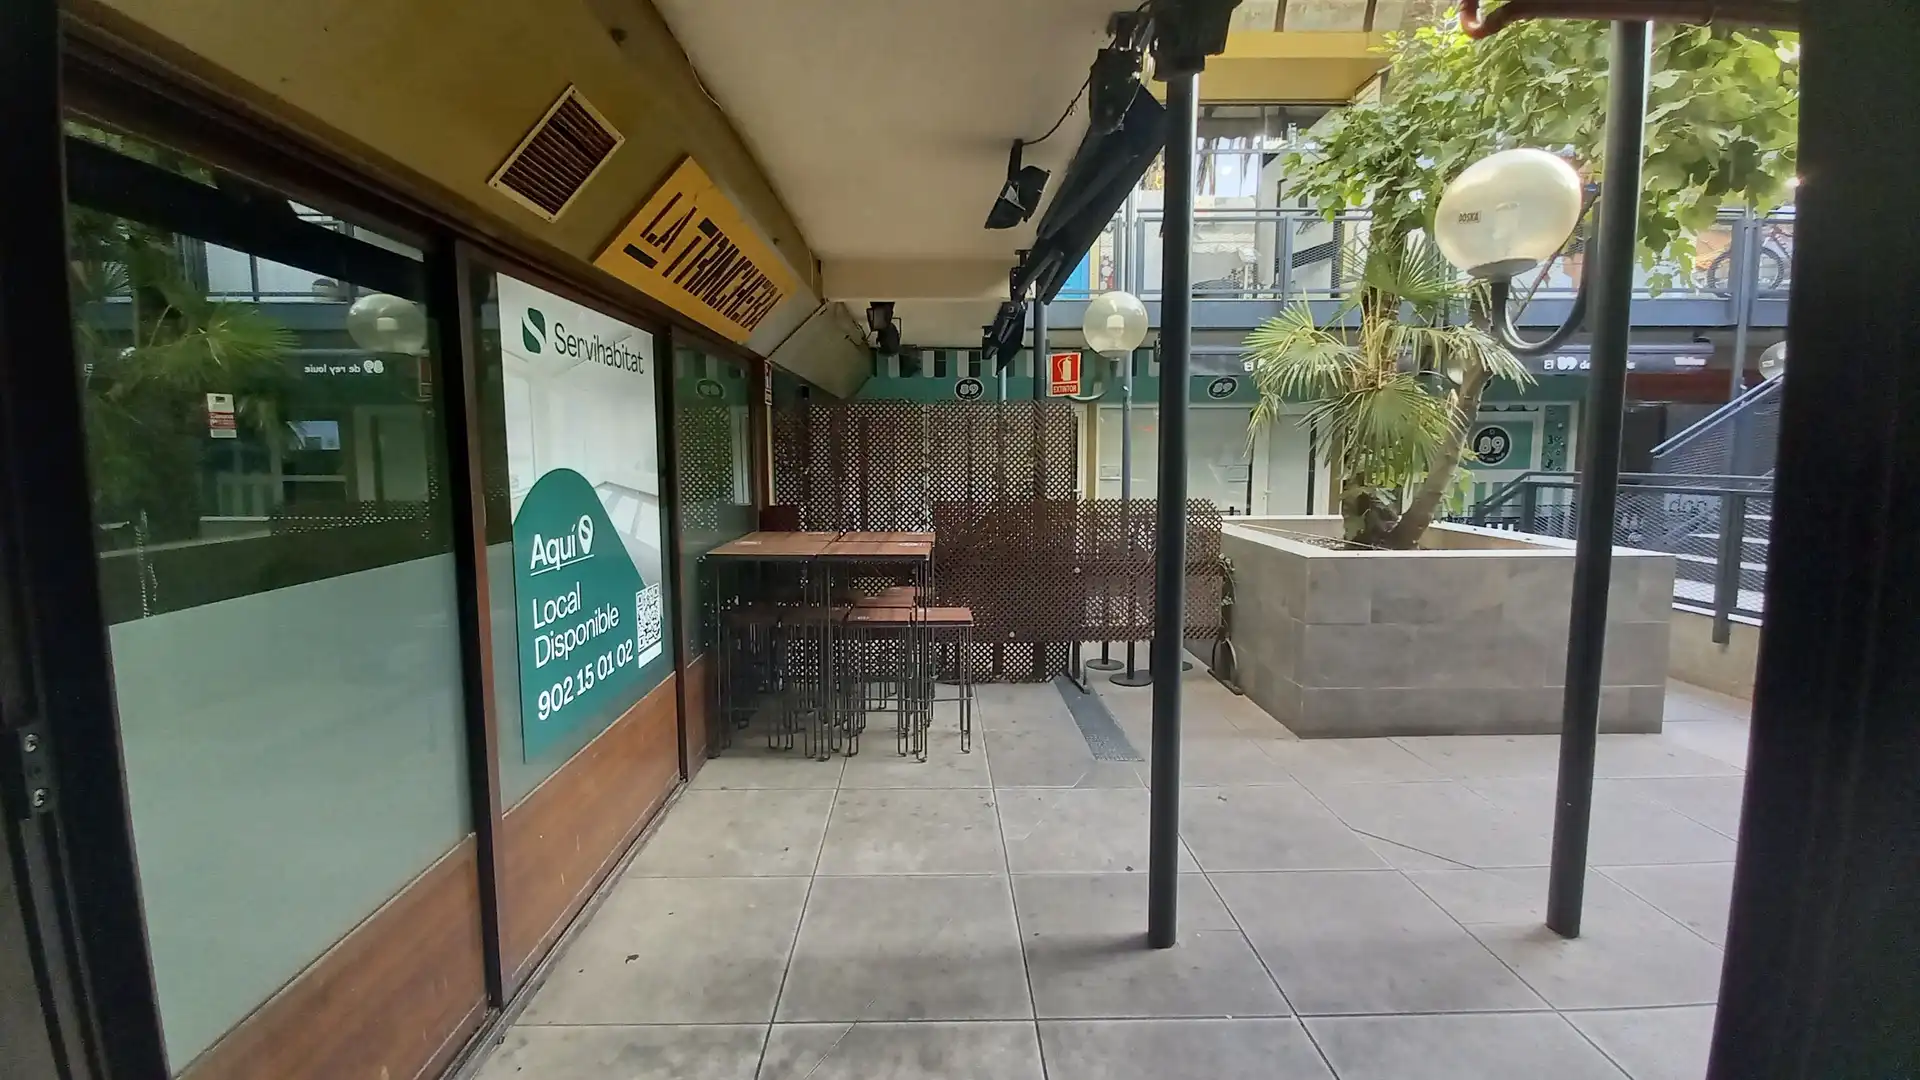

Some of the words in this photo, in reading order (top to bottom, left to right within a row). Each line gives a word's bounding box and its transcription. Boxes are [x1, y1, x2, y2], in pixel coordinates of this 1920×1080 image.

[640, 192, 697, 254] LA
[661, 217, 784, 333] TRINCHERA
[554, 322, 645, 375] Servihabitat
[960, 383, 979, 395] 89
[1053, 384, 1077, 394] EXTINTOR
[1479, 436, 1505, 454] 89
[530, 524, 577, 571] Aquí
[532, 581, 582, 630] Local
[534, 602, 620, 669] Disponible
[537, 675, 575, 721] 902
[576, 662, 595, 696] 15
[597, 650, 615, 681] 01
[616, 638, 634, 668] 02
